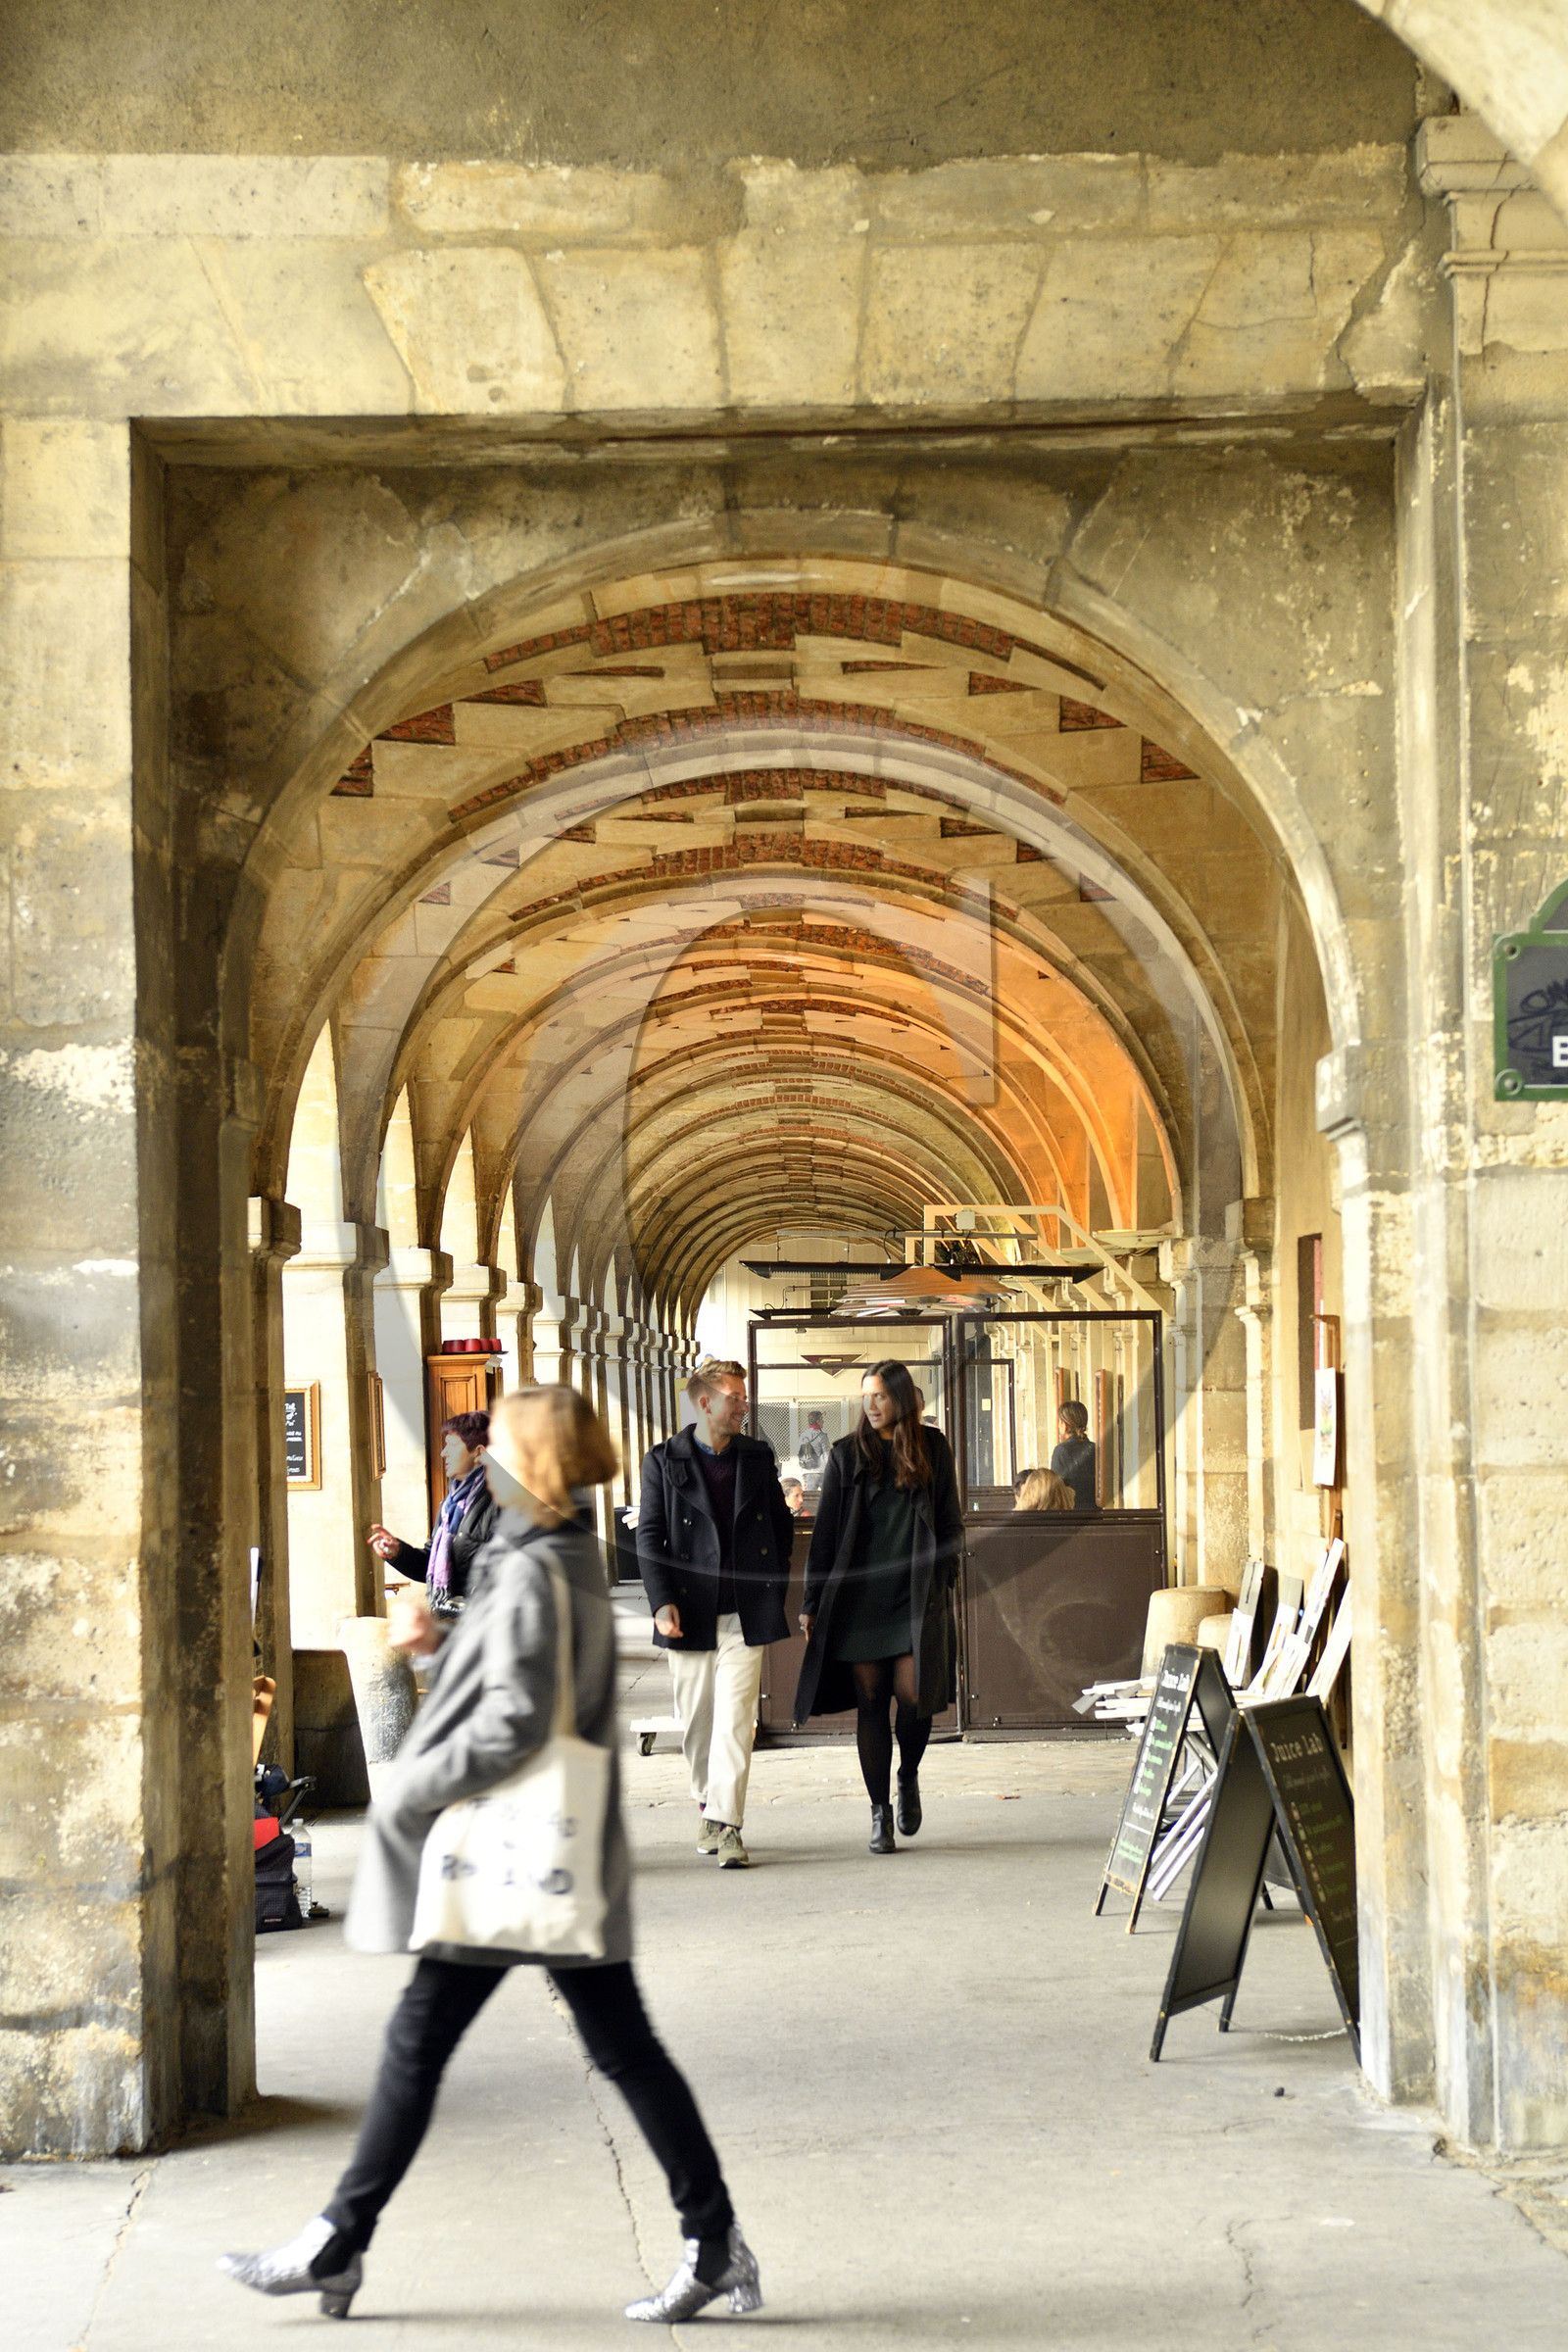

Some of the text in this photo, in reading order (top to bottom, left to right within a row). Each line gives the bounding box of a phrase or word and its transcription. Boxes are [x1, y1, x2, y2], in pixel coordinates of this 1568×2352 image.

[1161, 1669, 1190, 1691] Juice Lab
[1270, 1733, 1324, 1764] Juice Lab
